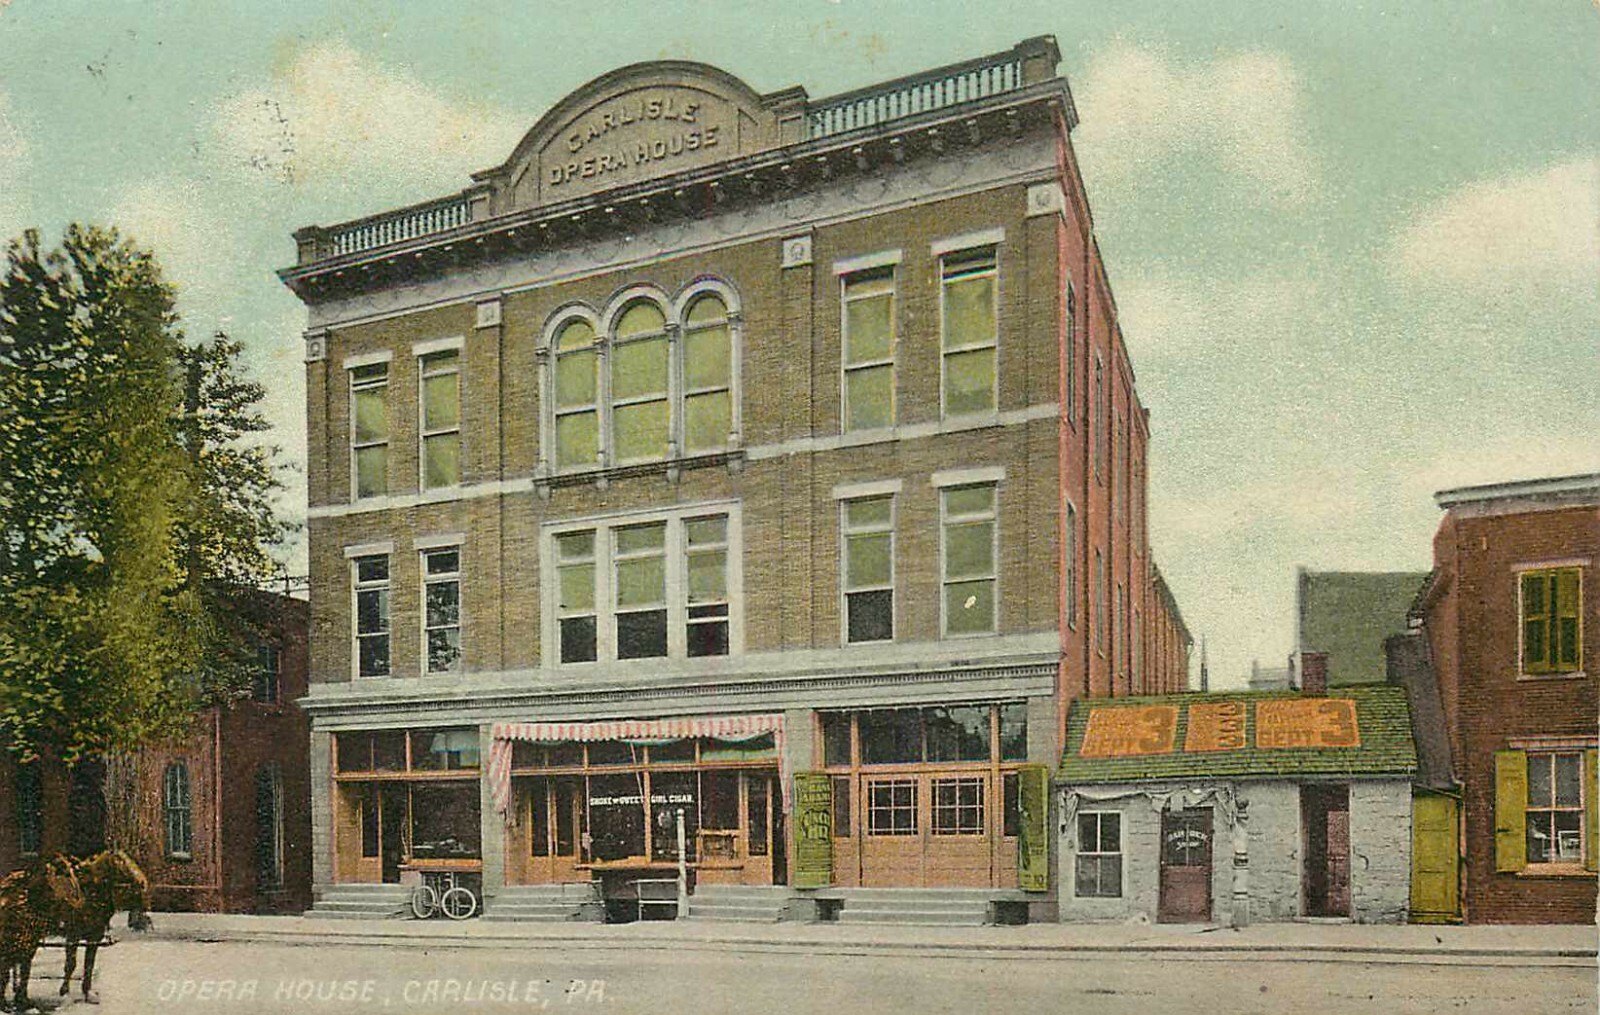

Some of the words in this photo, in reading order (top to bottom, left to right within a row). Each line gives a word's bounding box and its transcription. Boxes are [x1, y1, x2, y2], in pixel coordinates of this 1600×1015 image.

[567, 98, 700, 153] CARLISLE
[550, 151, 627, 185] OPERA
[635, 125, 719, 165] HOUSE
